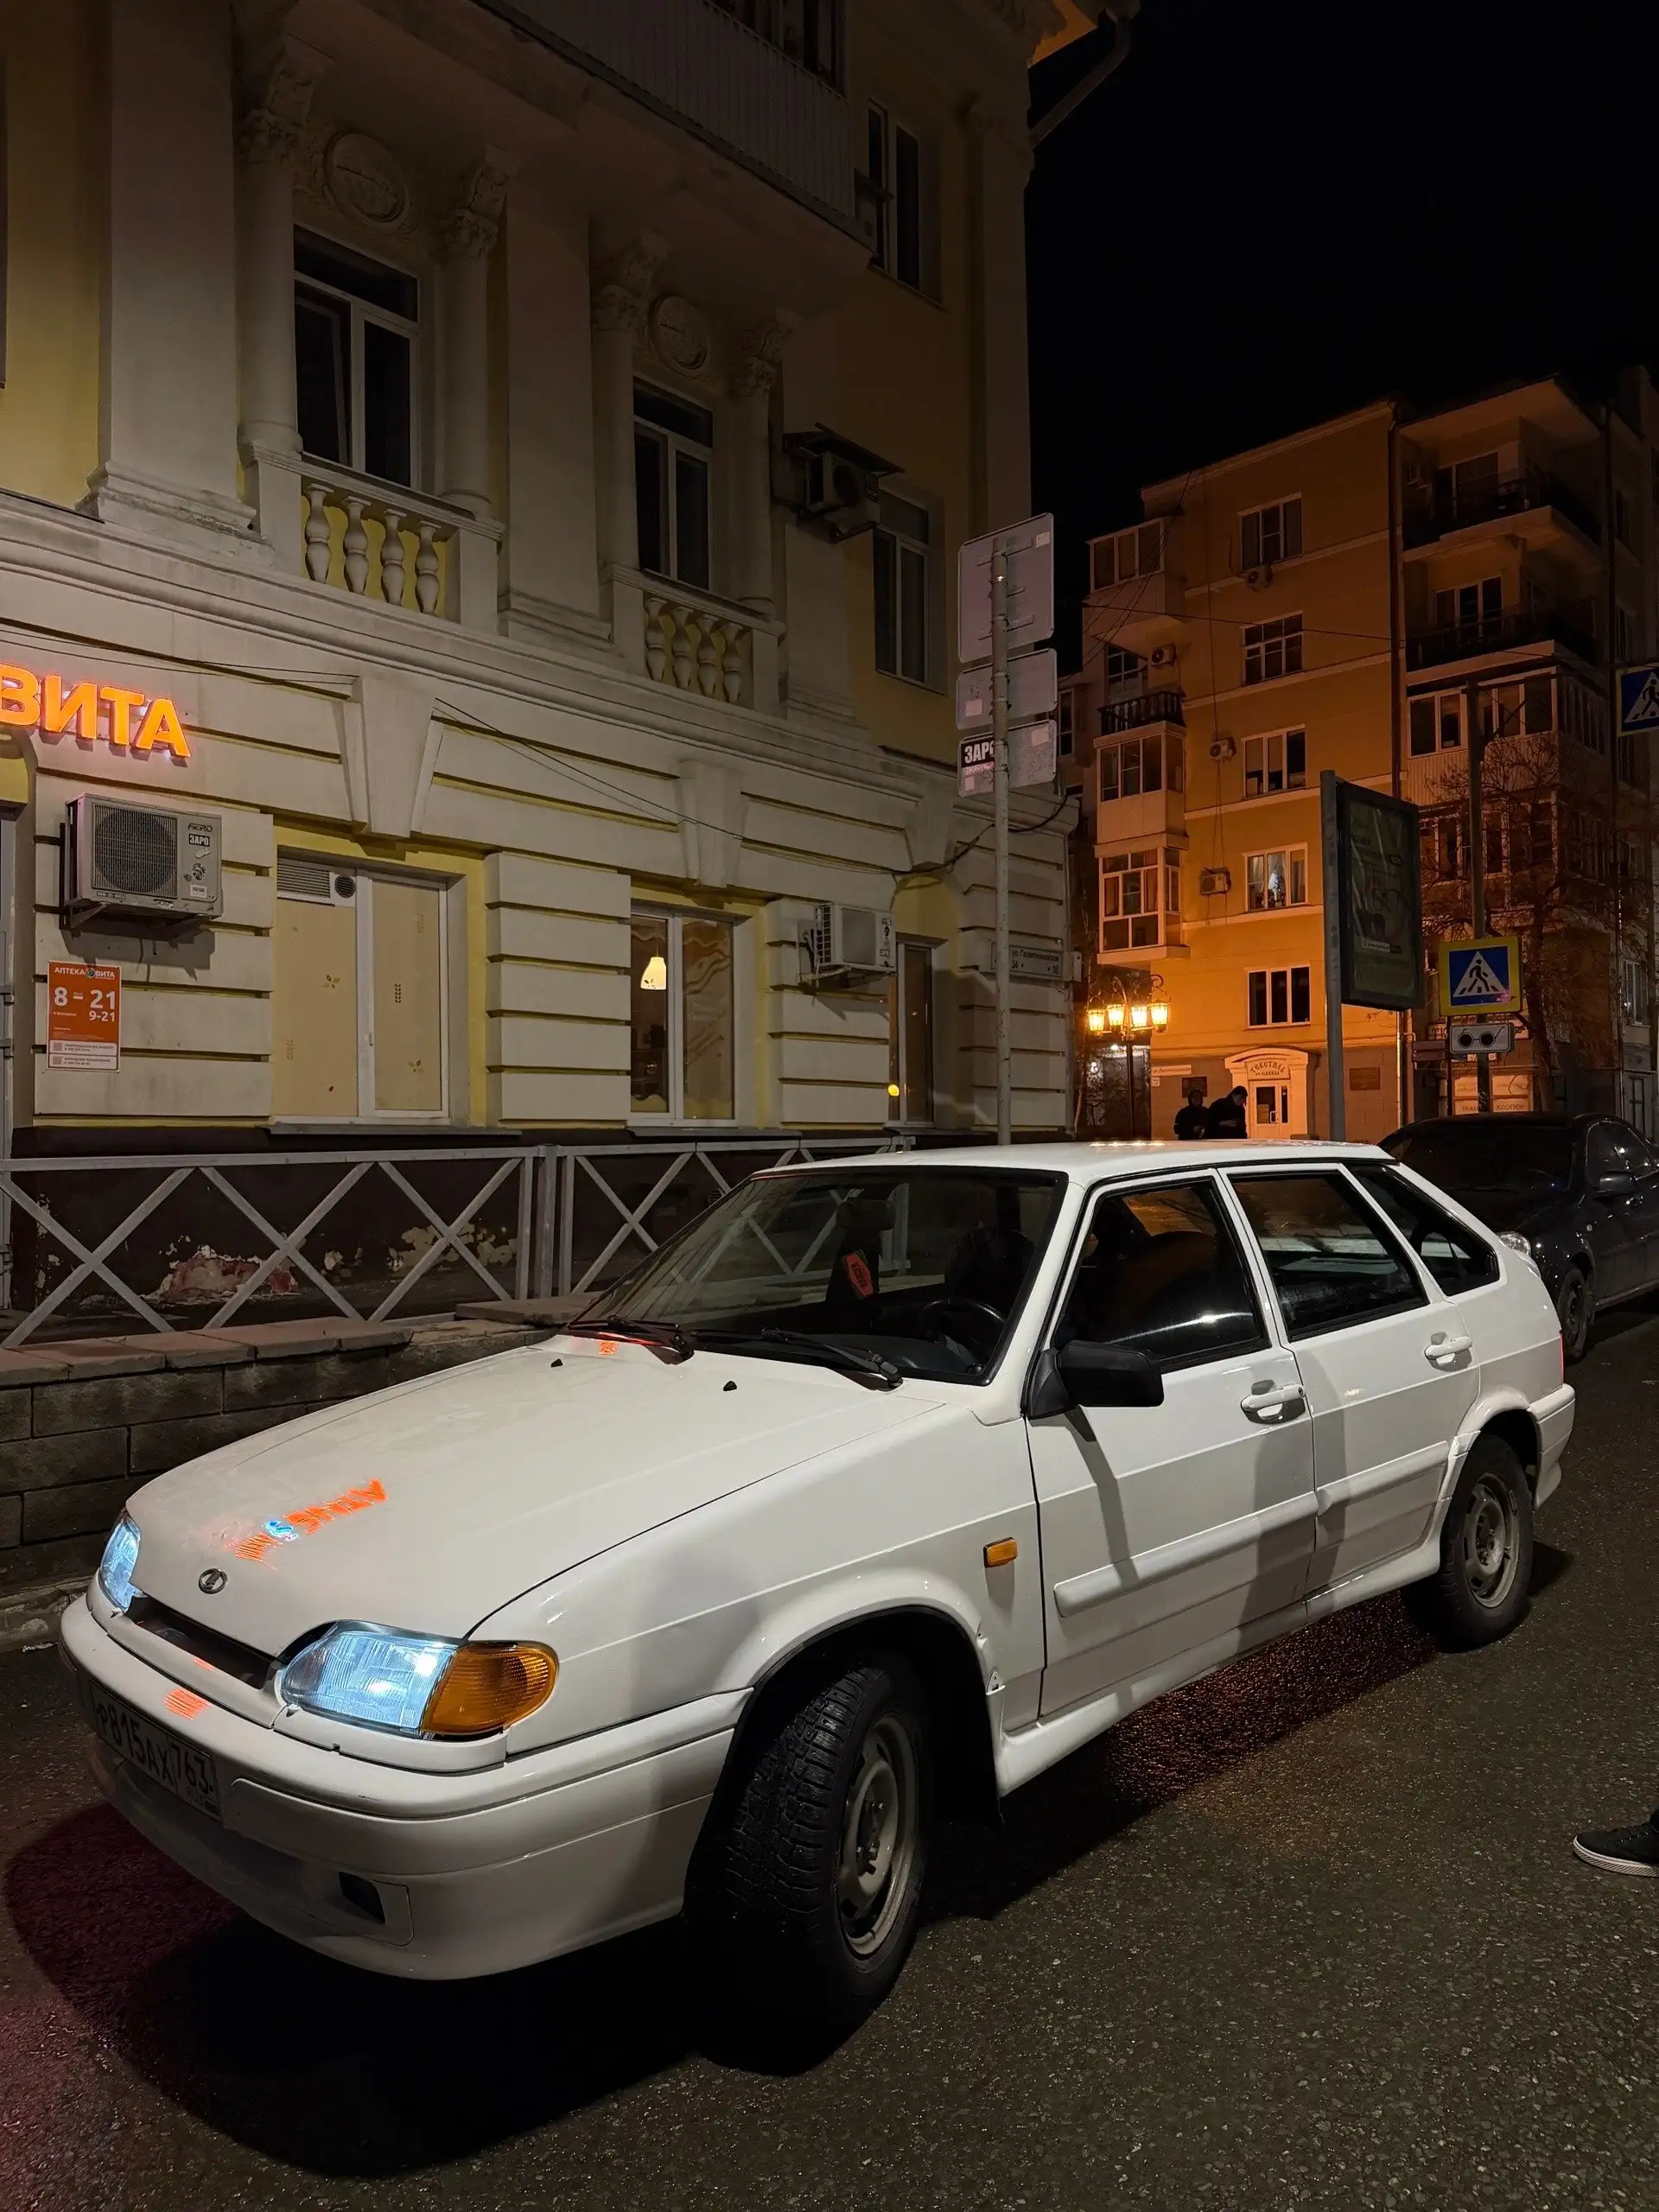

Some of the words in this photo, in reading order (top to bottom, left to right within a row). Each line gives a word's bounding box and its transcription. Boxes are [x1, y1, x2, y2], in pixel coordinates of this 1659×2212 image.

[0, 663, 191, 758] ВИТА
[54, 967, 85, 976] АПТЕКА
[54, 987, 68, 1007] 8
[90, 989, 116, 1010] 21
[89, 1010, 115, 1022] 9-21
